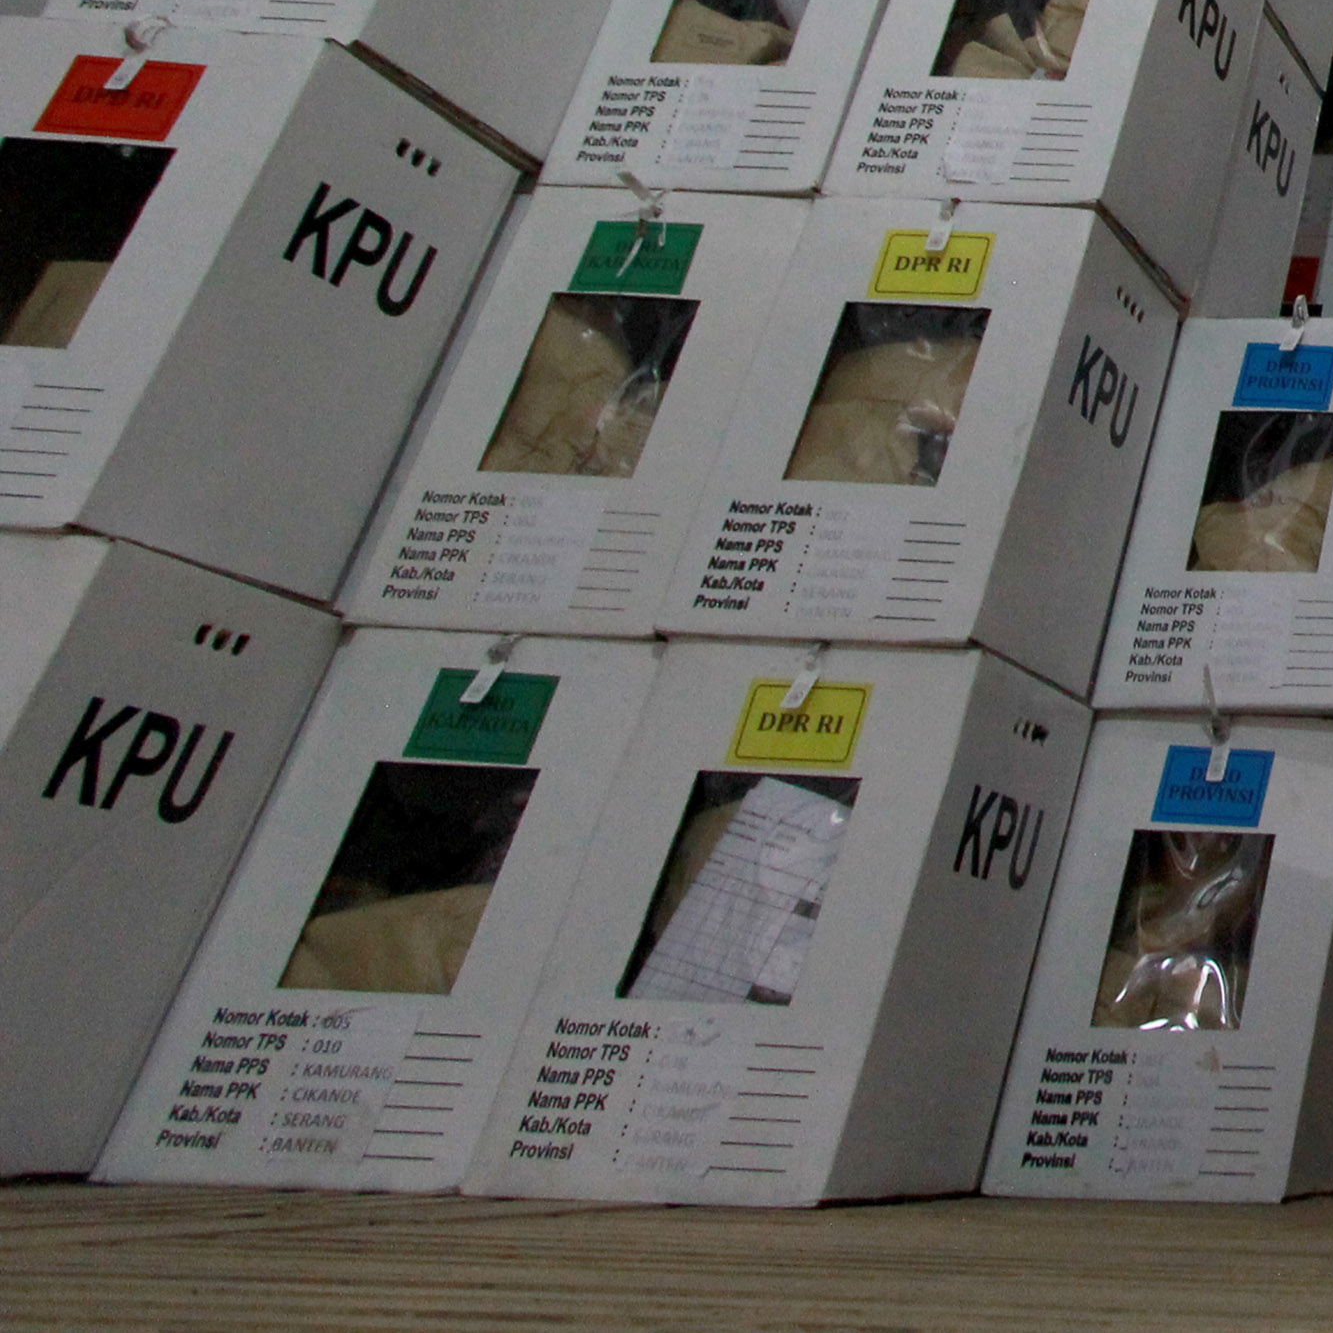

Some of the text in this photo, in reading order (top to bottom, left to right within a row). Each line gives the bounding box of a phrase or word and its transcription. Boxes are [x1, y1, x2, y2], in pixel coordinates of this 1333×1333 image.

[1246, 99, 1296, 197] KPU
[283, 181, 438, 317] KPU
[894, 256, 973, 275] DPR RI
[1069, 334, 1139, 448] KPU
[1246, 376, 1324, 393] PROVINSI
[729, 499, 814, 516] Nomor Kotak
[715, 538, 784, 553] Nama PPS
[701, 575, 765, 591] Kab./Kota
[693, 595, 750, 610] Provinsi
[757, 712, 845, 736] DPR RI
[42, 697, 234, 823] KPU
[1169, 786, 1254, 804] PROVINSI
[954, 785, 1044, 890] KPU
[213, 1007, 261, 1024] Nomor
[265, 1009, 308, 1028] Kotak
[555, 1018, 651, 1039] Nomor Kotak
[202, 1031, 341, 1053] Nomor TPS 010
[546, 1042, 631, 1061] Nomor TPS
[191, 1056, 231, 1074] Nama
[236, 1058, 271, 1075] PPS
[1046, 1048, 1129, 1064] Nomor Kotak
[537, 1066, 616, 1086] Nama PPS
[180, 1080, 221, 1098] Nama
[226, 1082, 261, 1100] PPK
[1036, 1089, 1103, 1104] Nama PPS
[528, 1091, 608, 1111] Nama PPK
[168, 1104, 242, 1124] Kab./Kota
[518, 1115, 592, 1136] Kab./Kota
[156, 1129, 222, 1150] Provinsi
[1026, 1131, 1088, 1147] Kab./Kota
[510, 1140, 574, 1160] Provinsi
[1021, 1152, 1076, 1168] Provinsi
